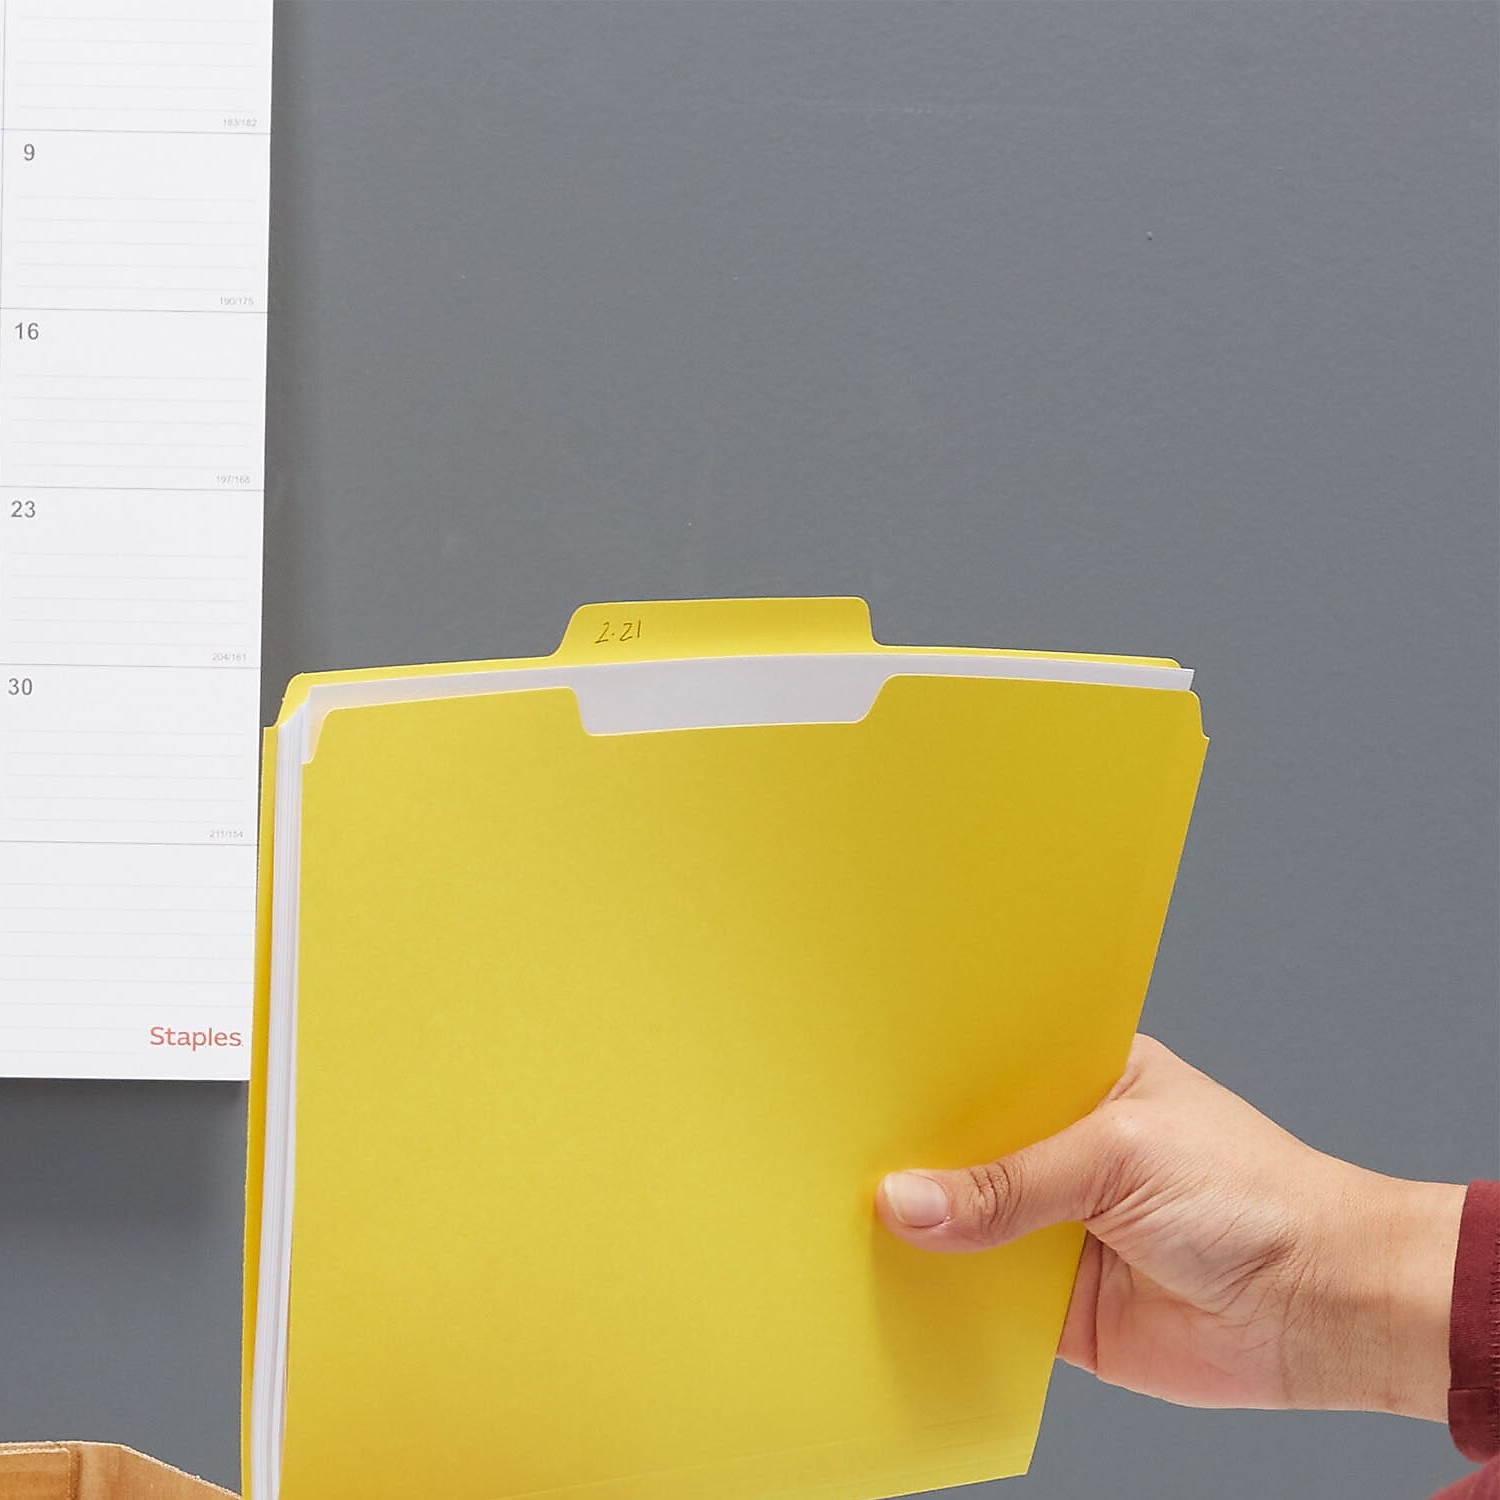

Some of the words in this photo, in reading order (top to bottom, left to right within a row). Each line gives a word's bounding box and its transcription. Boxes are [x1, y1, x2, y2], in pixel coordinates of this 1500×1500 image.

[23, 144, 36, 161] 9
[14, 323, 40, 340] 16
[10, 500, 36, 518] 23
[8, 678, 33, 695] 30
